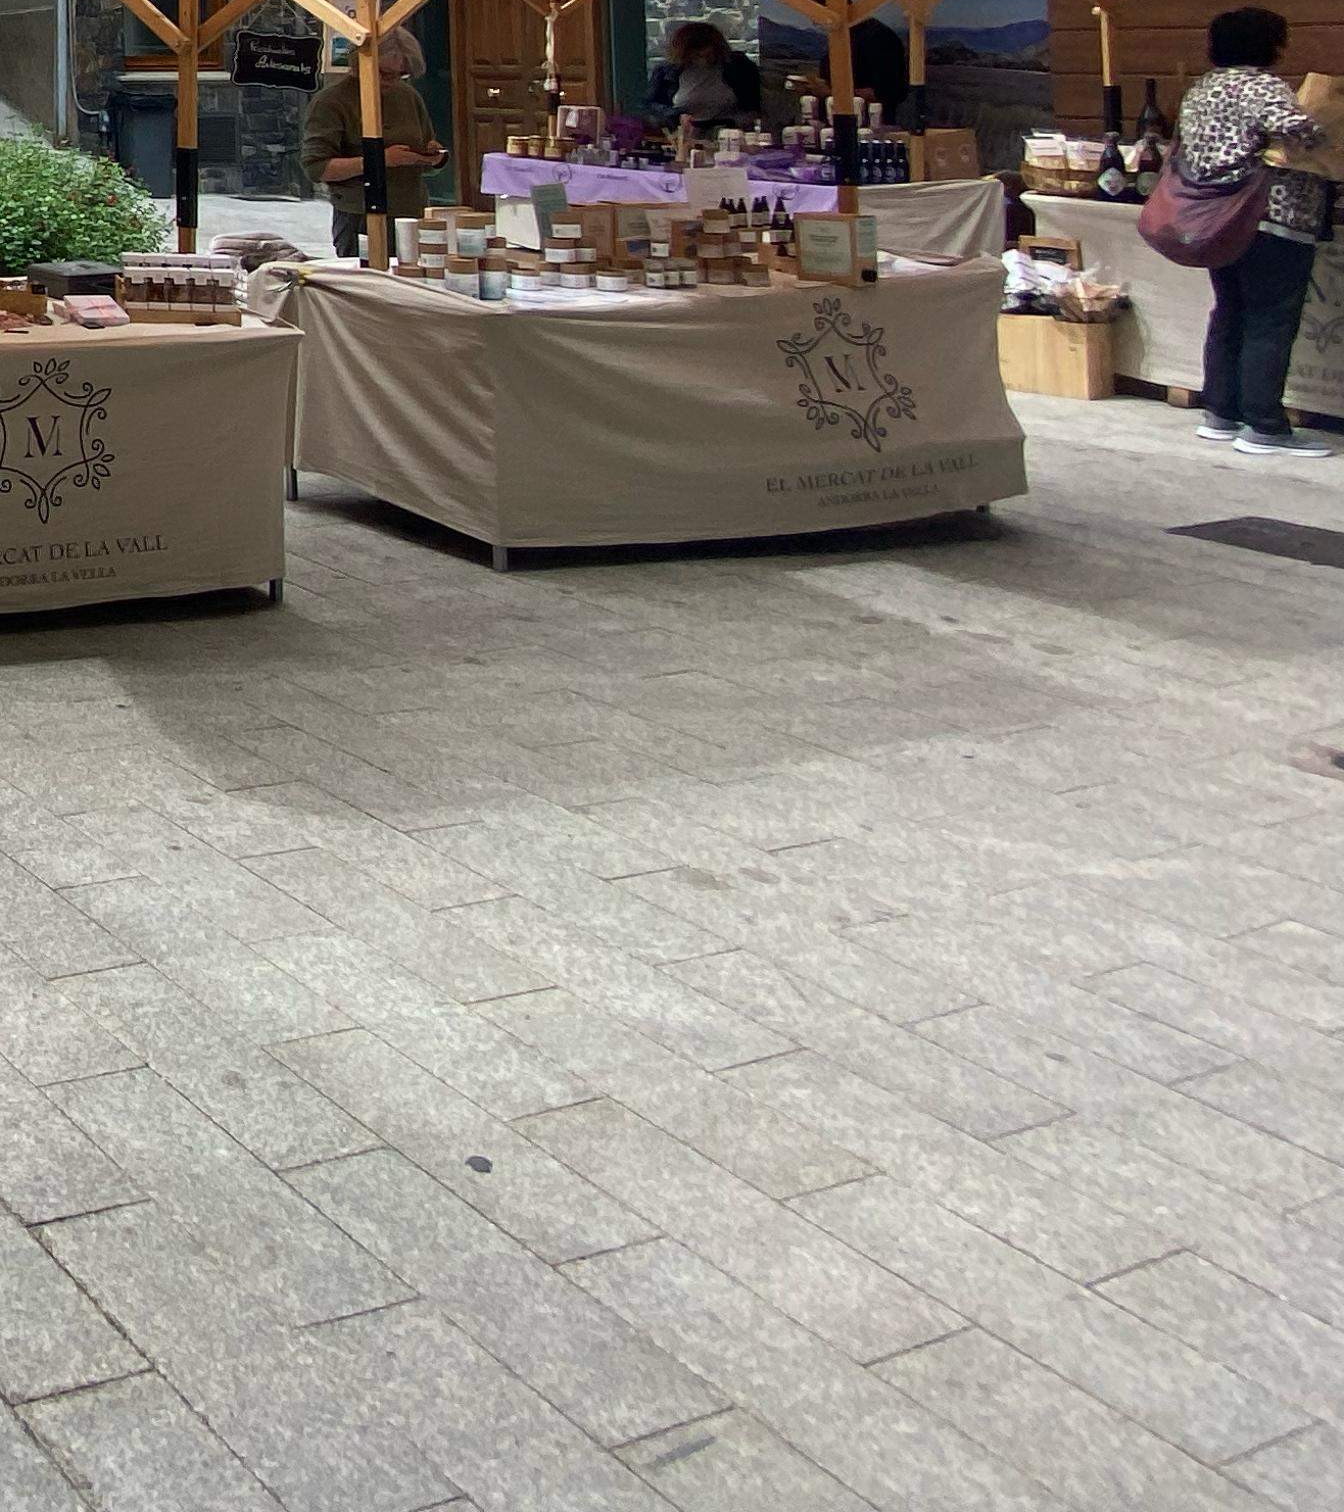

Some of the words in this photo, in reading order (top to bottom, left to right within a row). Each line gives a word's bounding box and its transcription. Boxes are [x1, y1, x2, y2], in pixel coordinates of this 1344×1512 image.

[24, 416, 63, 458] M
[766, 477, 791, 493] EL
[796, 468, 876, 489] MERCAT
[881, 467, 907, 481] DE
[911, 462, 934, 477] LA
[49, 542, 79, 561] DE
[85, 539, 110, 558] LA
[116, 535, 168, 554] VALL
